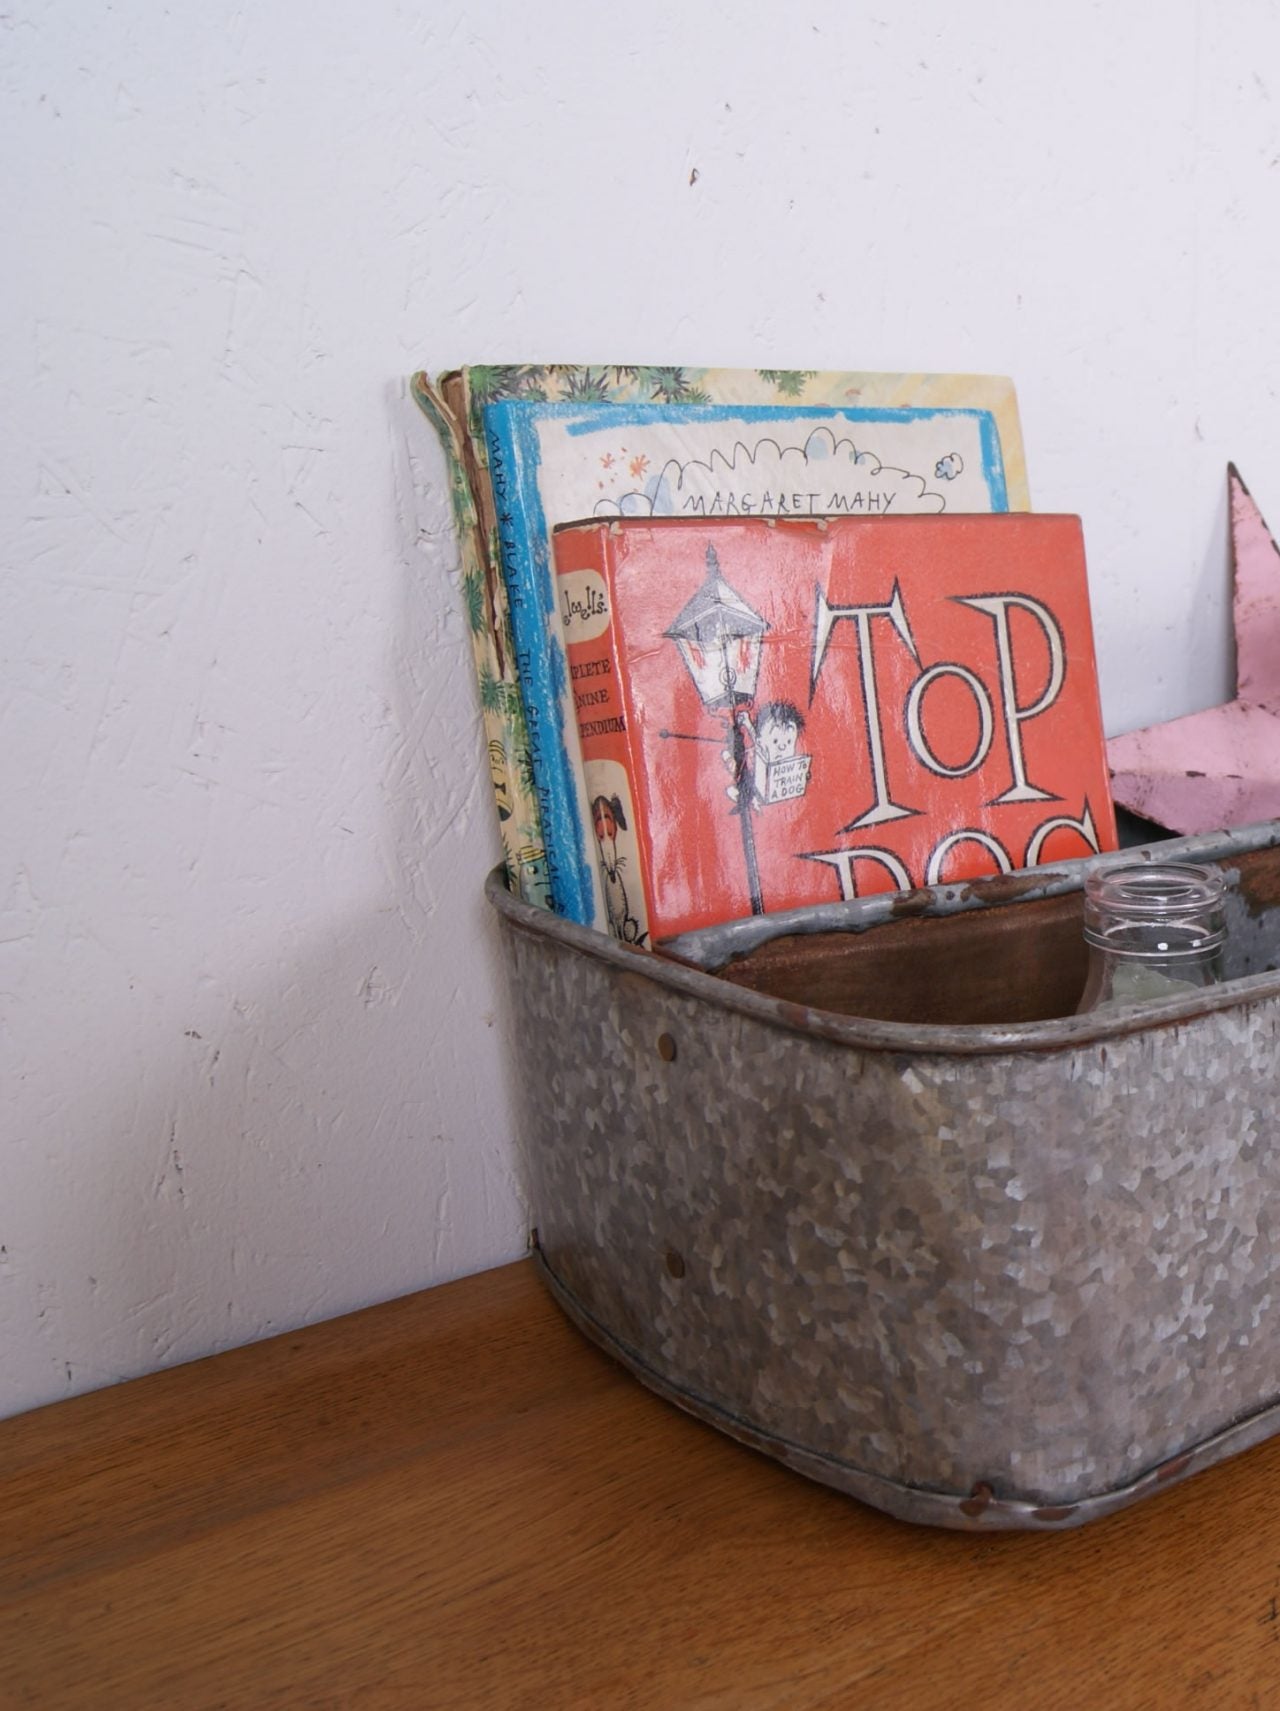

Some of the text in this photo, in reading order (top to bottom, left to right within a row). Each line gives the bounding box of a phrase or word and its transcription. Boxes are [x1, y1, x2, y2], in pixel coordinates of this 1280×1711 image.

[682, 490, 897, 515] MARGARET MAHY
[489, 429, 523, 609] MAHY BLAKE
[570, 659, 611, 680] PLETE
[518, 649, 534, 687] THE
[527, 705, 544, 770] GREAT
[573, 688, 610, 710] NINE
[808, 575, 1068, 836] TOP
[579, 716, 627, 738] PENDIUM
[773, 763, 795, 776] HOW
[773, 773, 803, 788] TRAIN
[771, 784, 804, 799] A DOG
